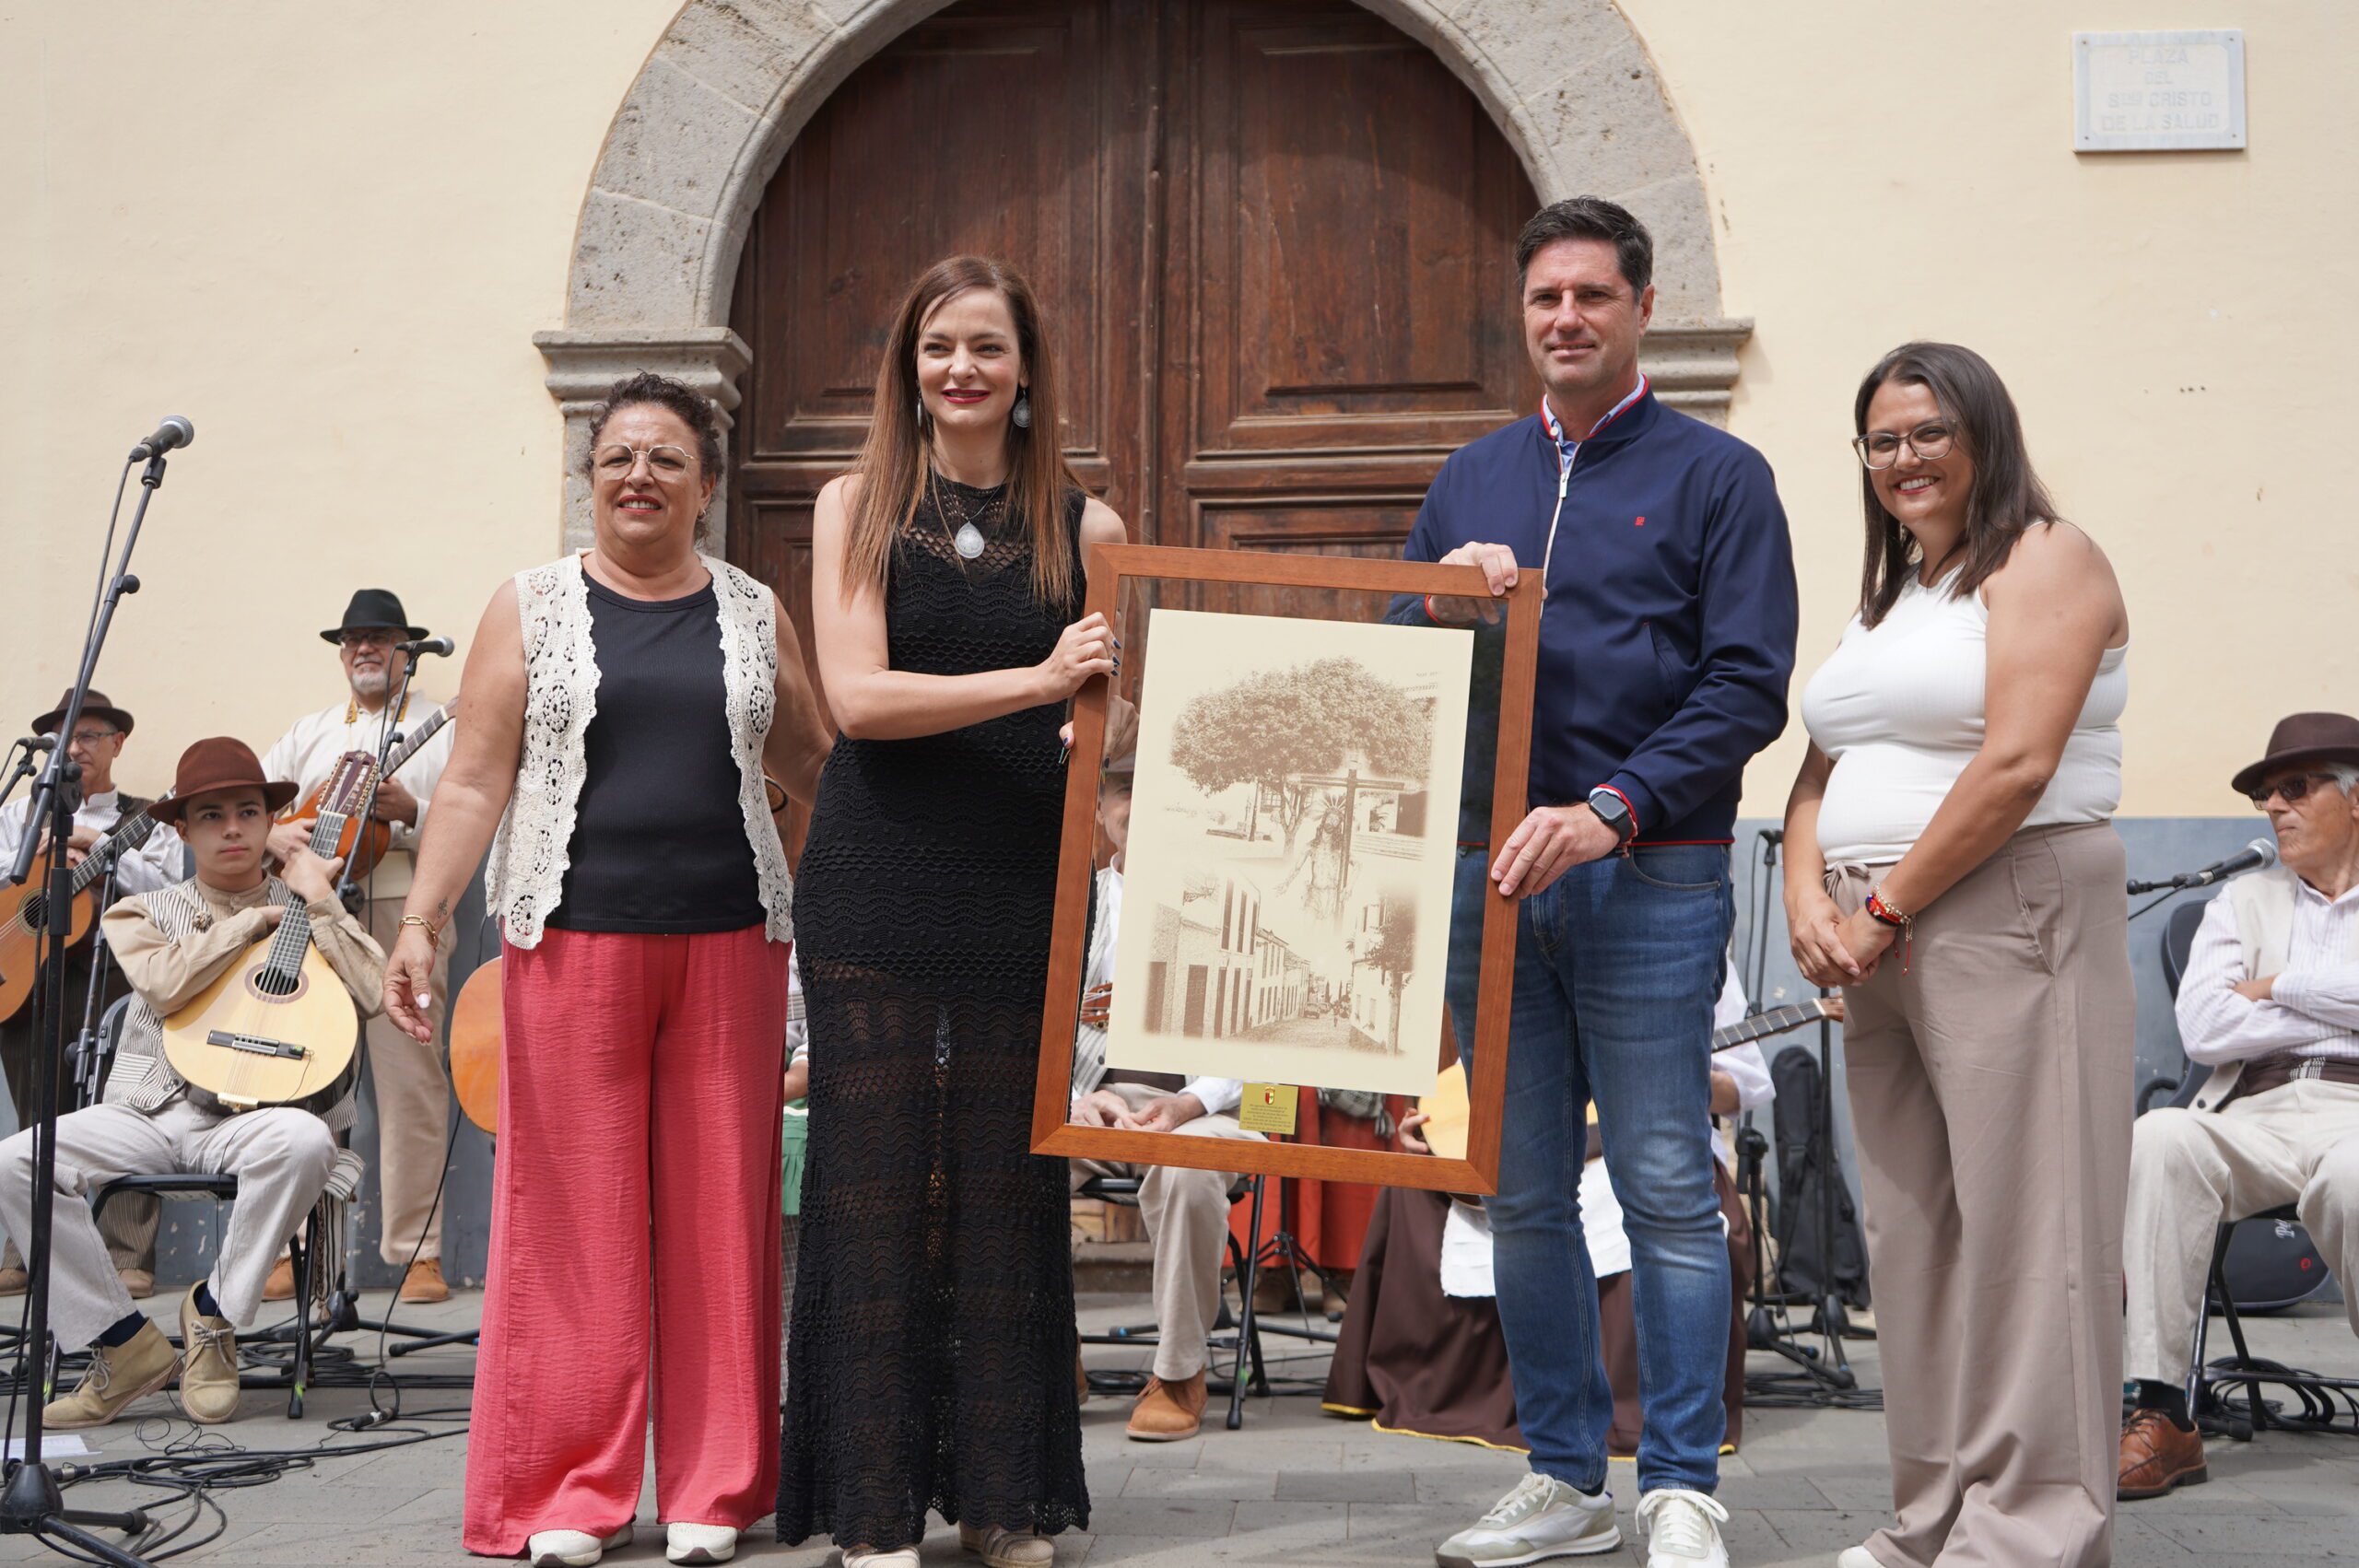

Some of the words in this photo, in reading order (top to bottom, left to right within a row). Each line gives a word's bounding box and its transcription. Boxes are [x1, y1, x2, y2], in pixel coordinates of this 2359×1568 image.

[2128, 48, 2189, 64] PLAZA
[2144, 70, 2174, 85] DEL
[2149, 90, 2212, 108] CRISTO
[2101, 114, 2126, 132] DE
[2130, 114, 2155, 131] LA
[2162, 112, 2219, 131] SALUD
